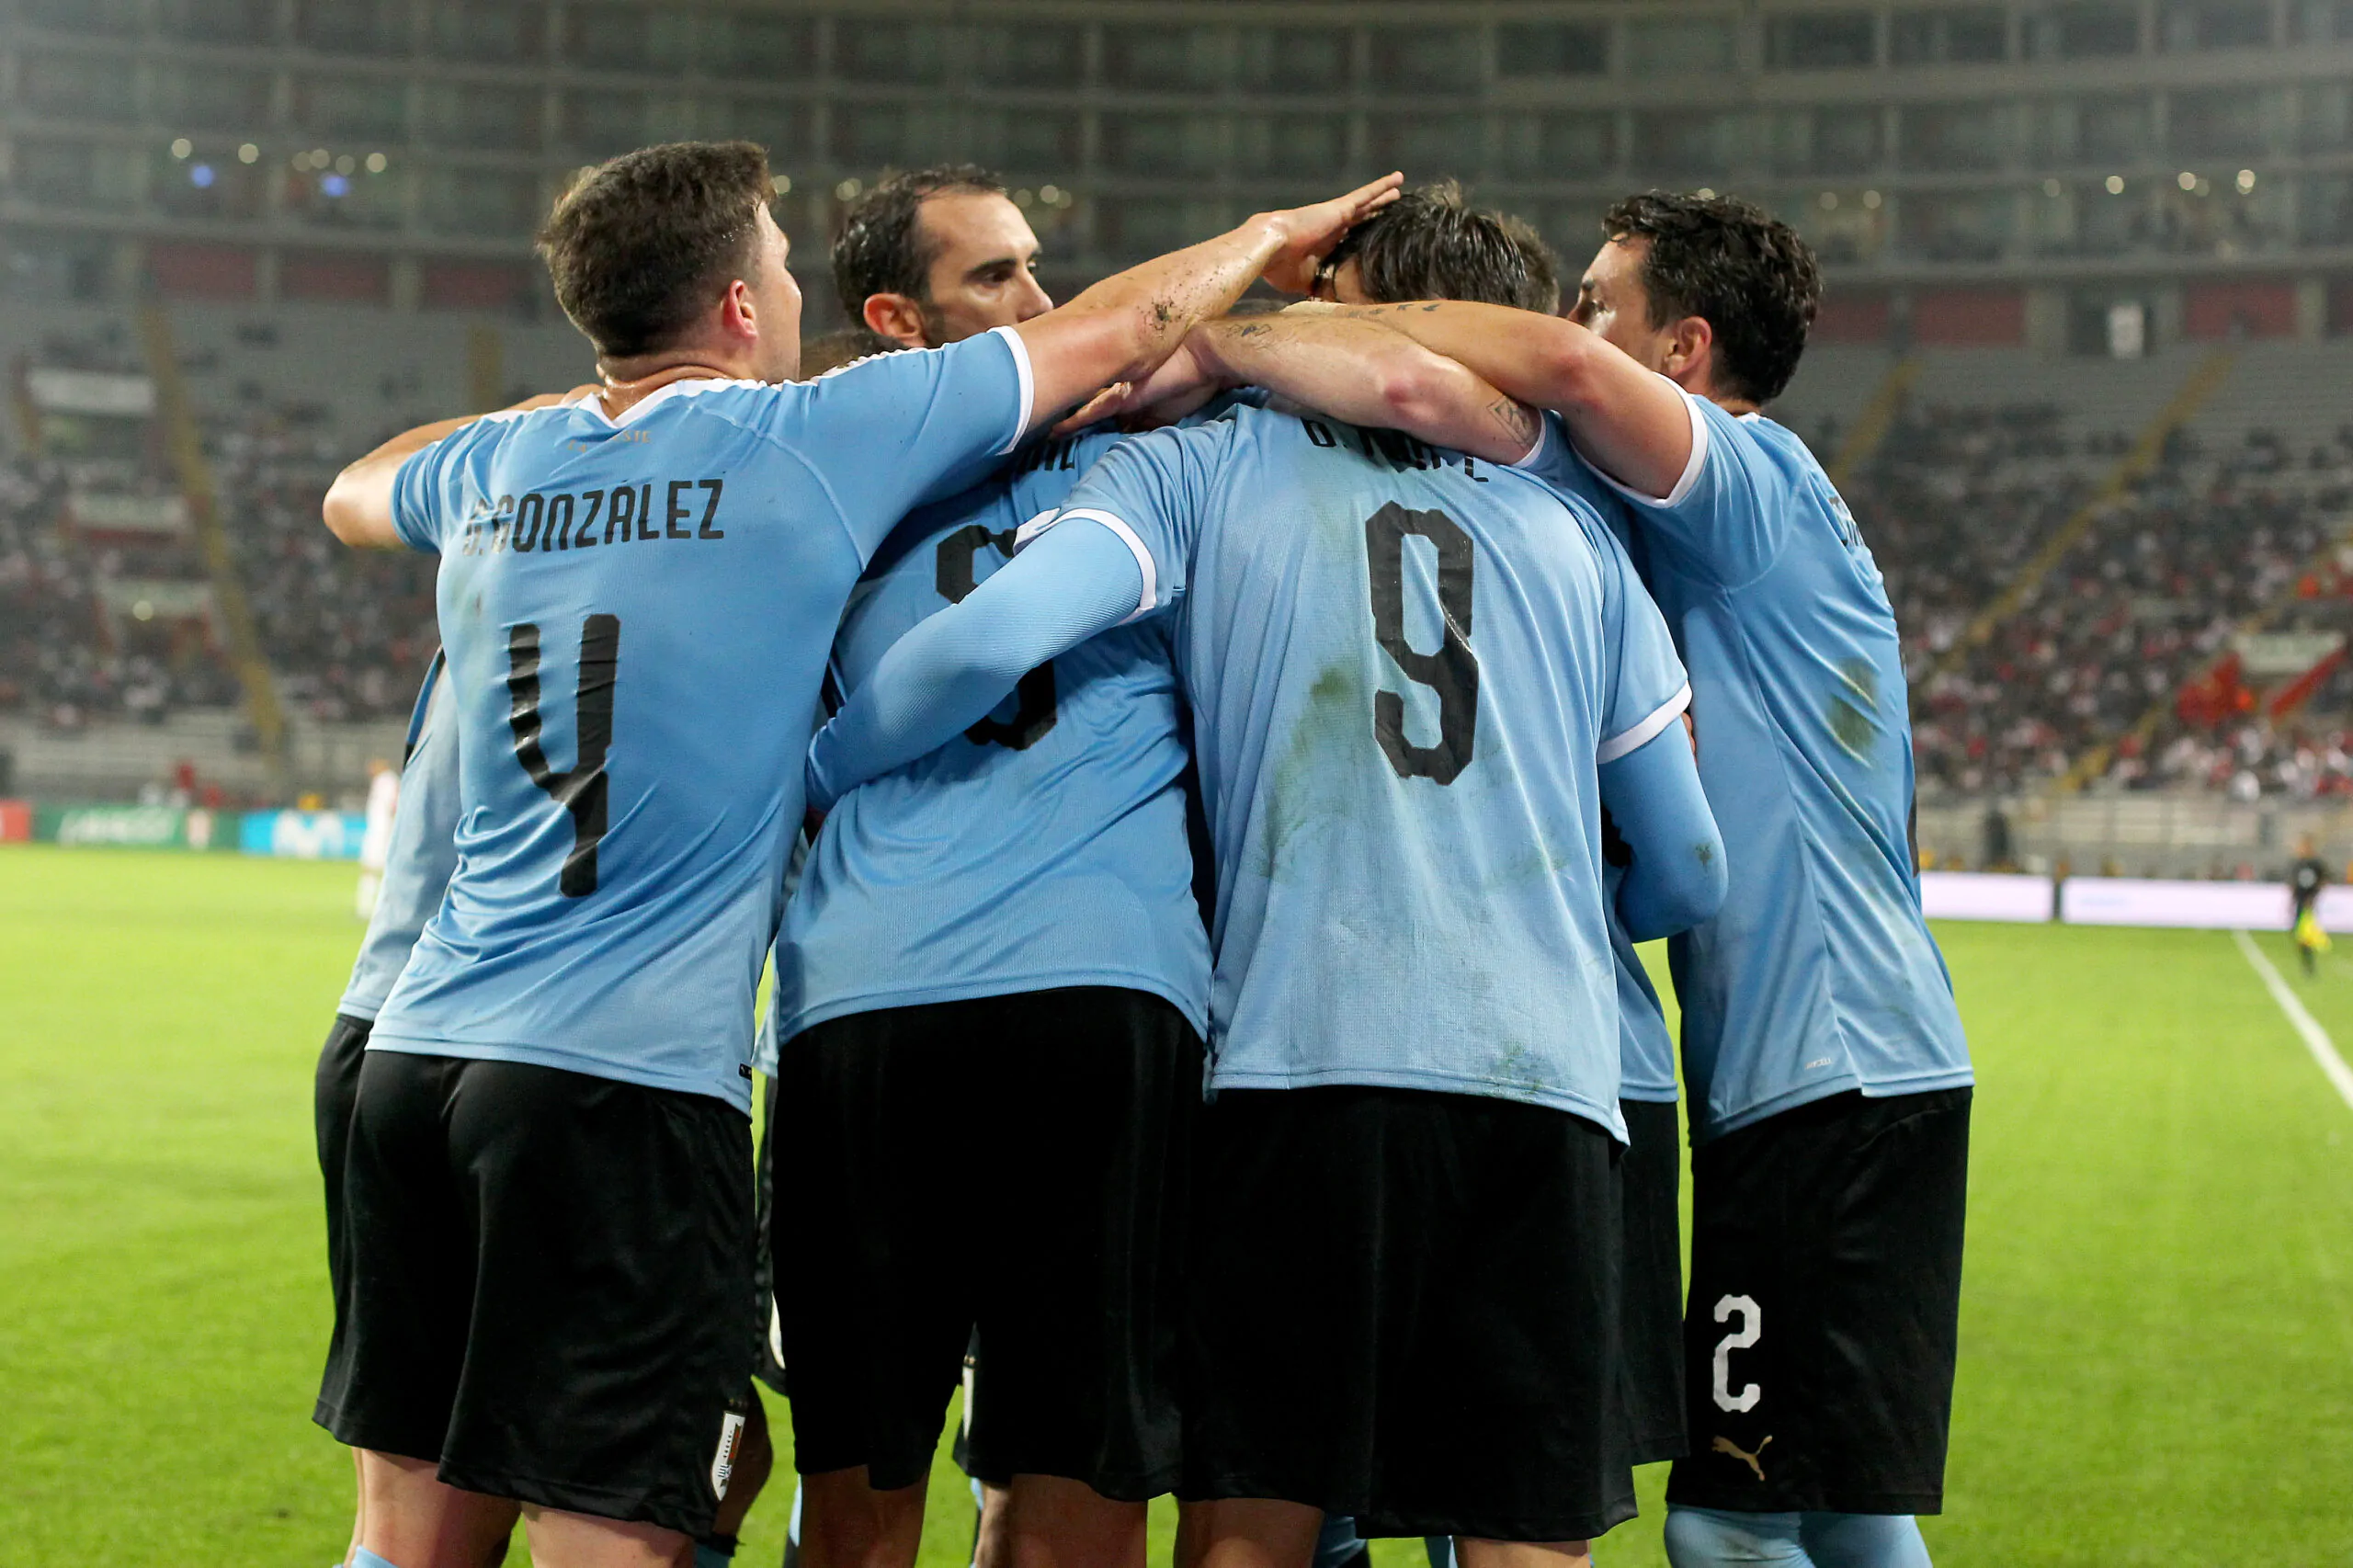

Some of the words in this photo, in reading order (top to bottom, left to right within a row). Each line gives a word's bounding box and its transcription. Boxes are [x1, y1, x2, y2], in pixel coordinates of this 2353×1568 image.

[508, 613, 620, 898] 4
[1366, 499, 1479, 786] 9
[1712, 1294, 1762, 1413] 2
